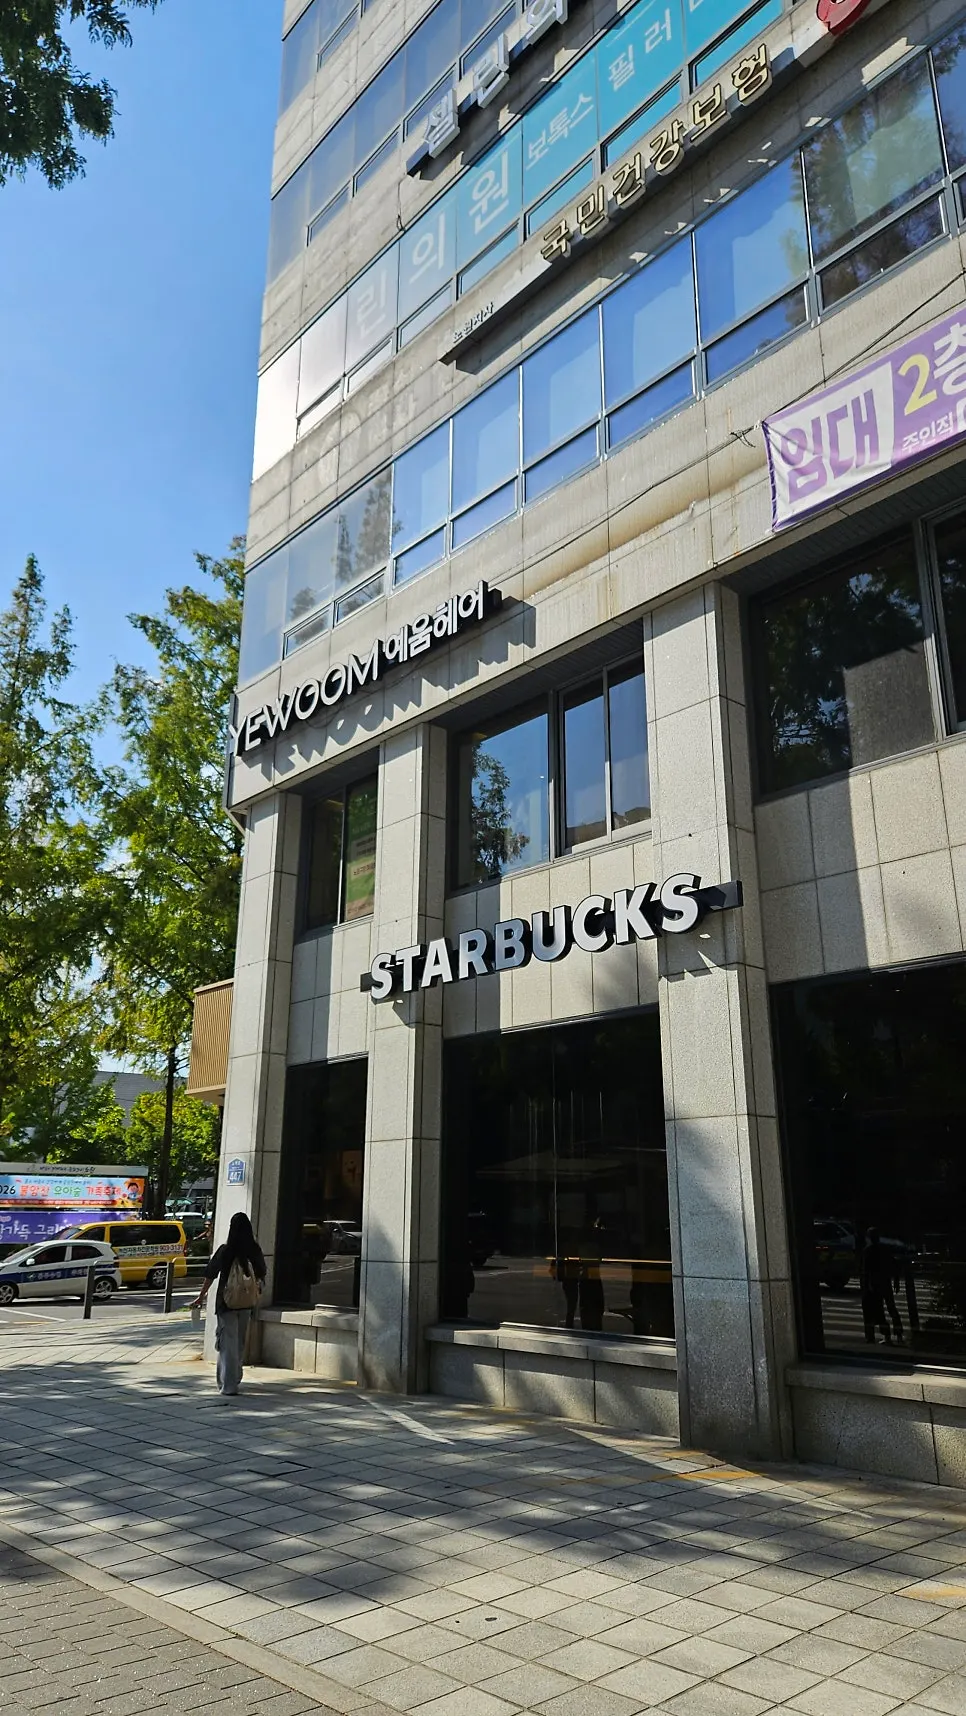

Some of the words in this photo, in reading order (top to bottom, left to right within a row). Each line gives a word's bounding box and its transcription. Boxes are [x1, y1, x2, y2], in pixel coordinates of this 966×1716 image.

[541, 43, 772, 260] 국민건강보험
[780, 388, 881, 504] 임대
[228, 638, 382, 756] YEWOOM
[382, 580, 487, 663] 예움헤어
[370, 872, 702, 1001] STARBUCKS
[229, 1171, 242, 1182] 447
